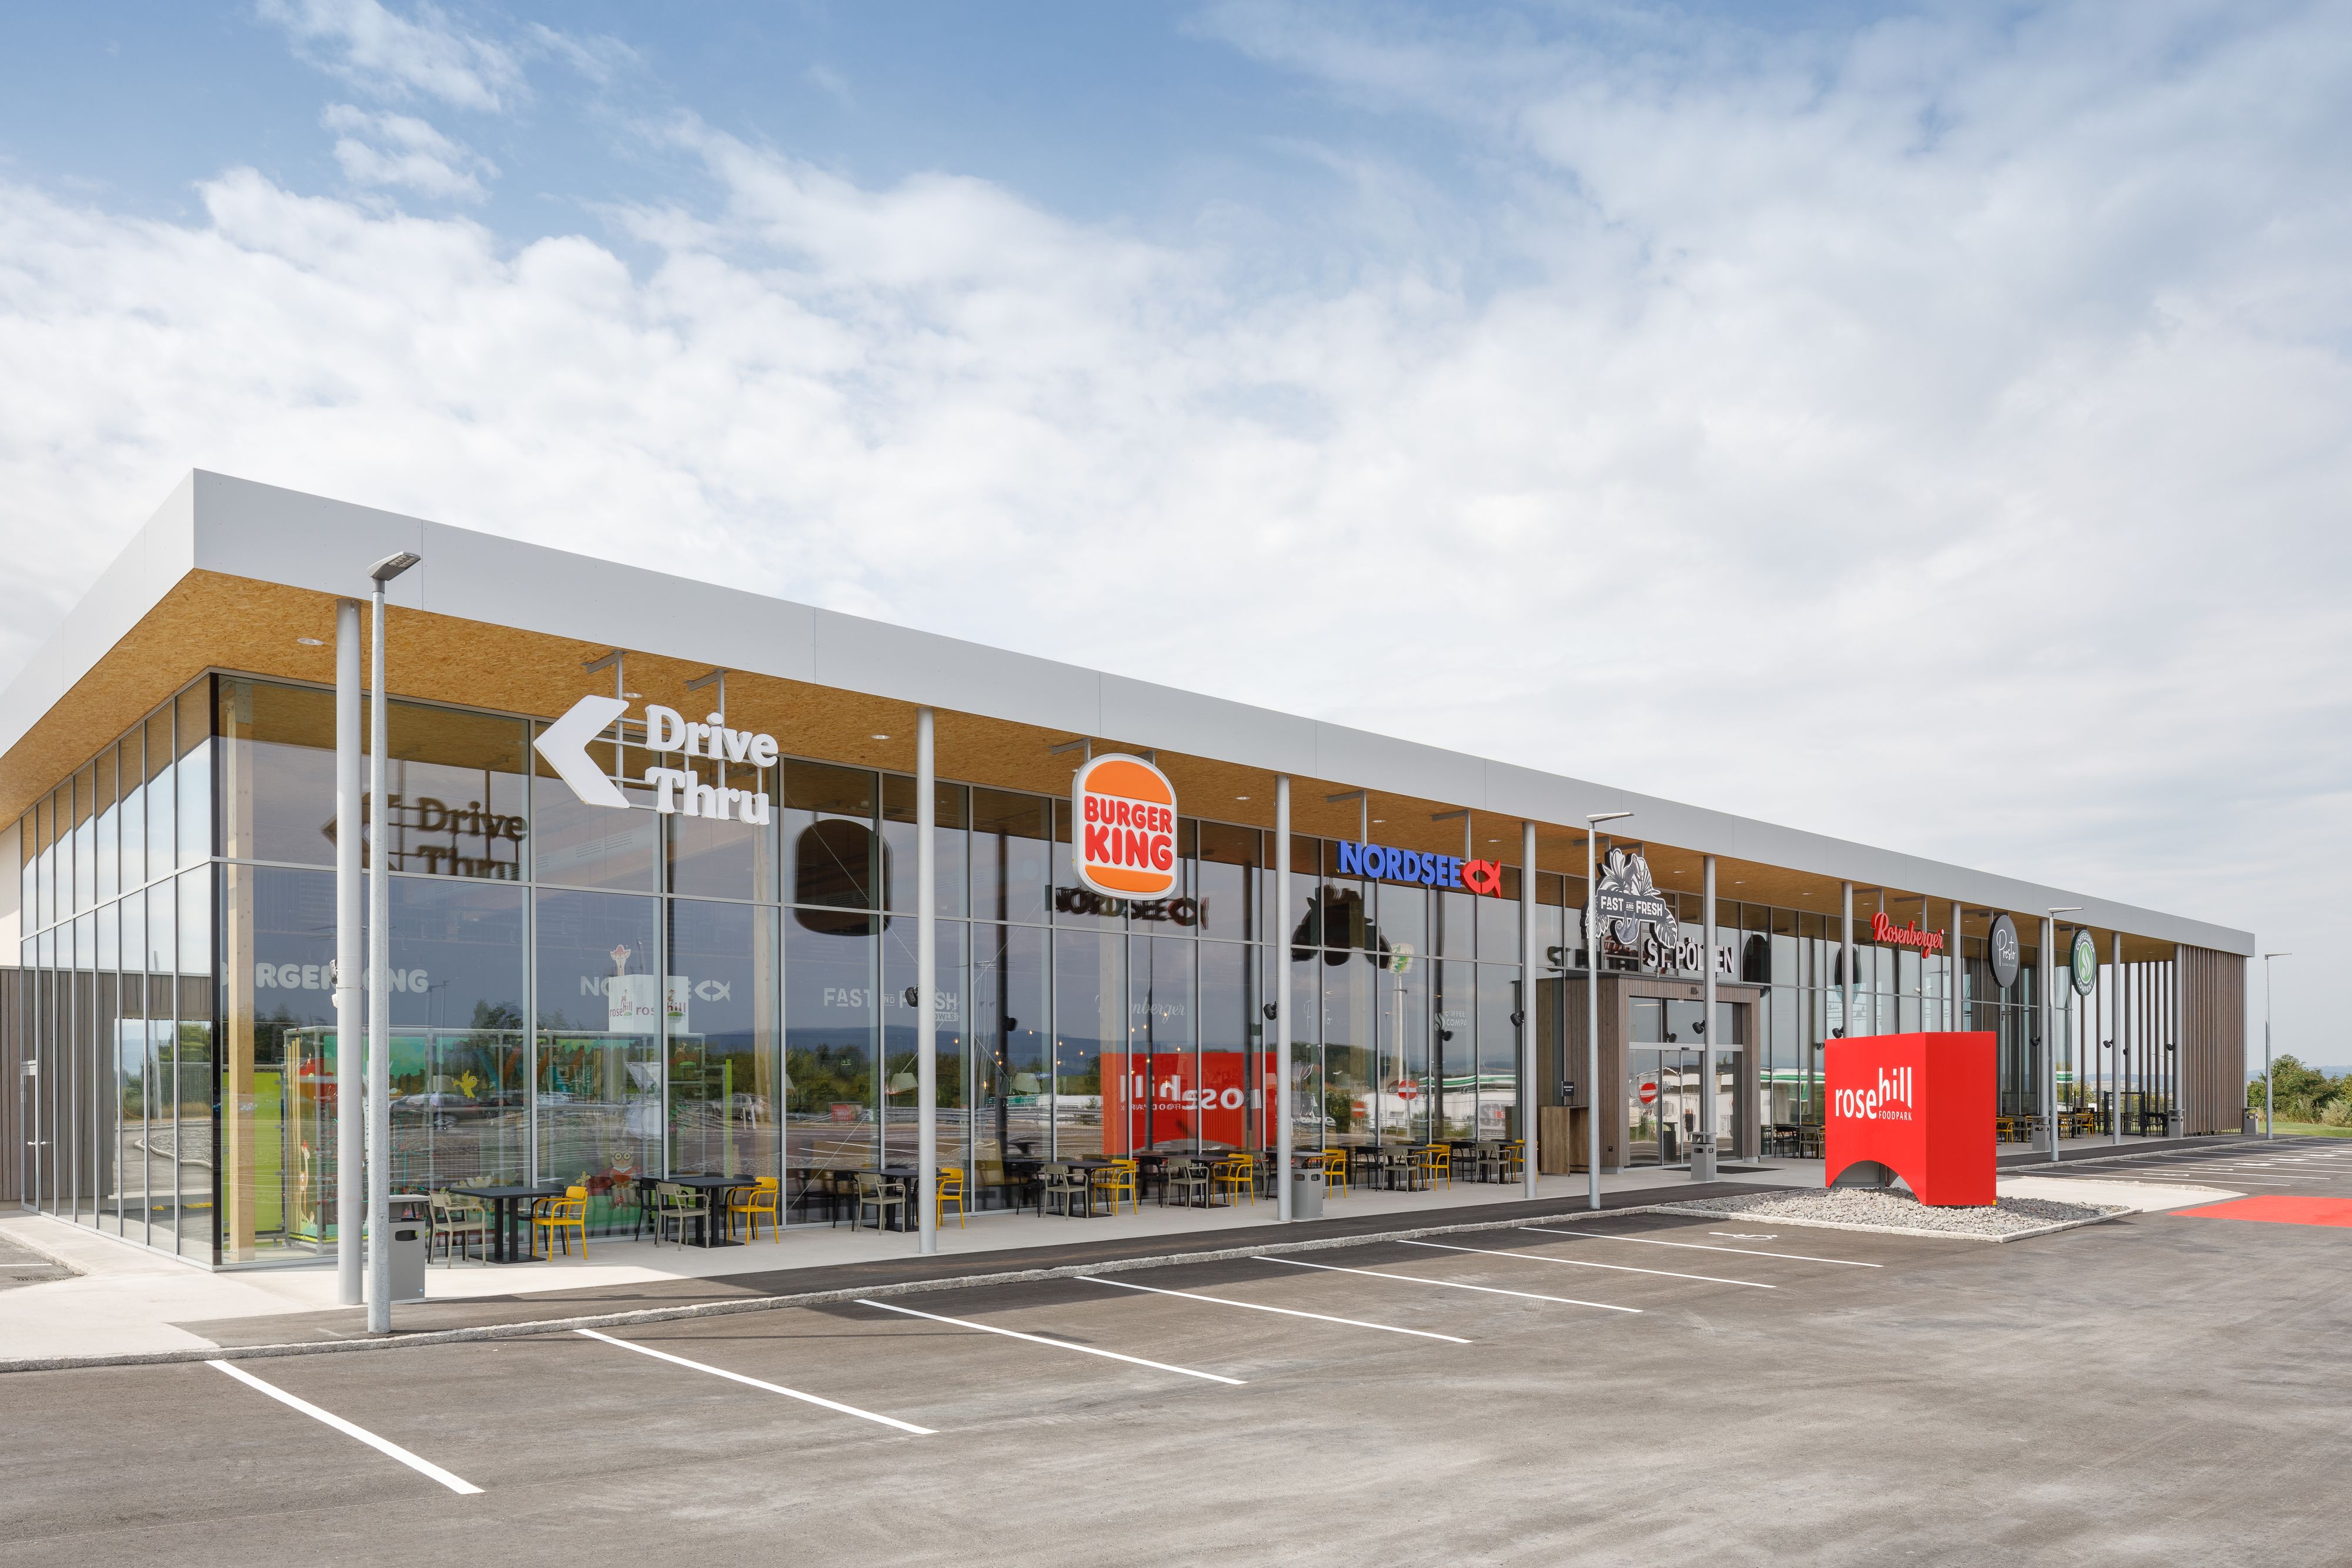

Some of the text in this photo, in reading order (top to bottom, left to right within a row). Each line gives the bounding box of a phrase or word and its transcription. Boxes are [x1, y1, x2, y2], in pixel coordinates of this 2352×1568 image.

[645, 704, 779, 767] Drive
[645, 767, 770, 825] Thru
[1084, 795, 1172, 834] BURGER
[1085, 823, 1173, 871] KING
[1337, 841, 1461, 888] NORDSEE
[1601, 895, 1663, 917] FAST AND FRESH
[1871, 912, 1944, 958] Rosenberger
[1996, 929, 2016, 967] Presto
[2076, 932, 2095, 953] COFFEESHOP
[1676, 937, 1734, 974] PÖLEN
[2077, 978, 2093, 993] COMPANY
[1835, 1066, 1912, 1119] rosehill
[1879, 1110, 1912, 1121] FOODPARK
